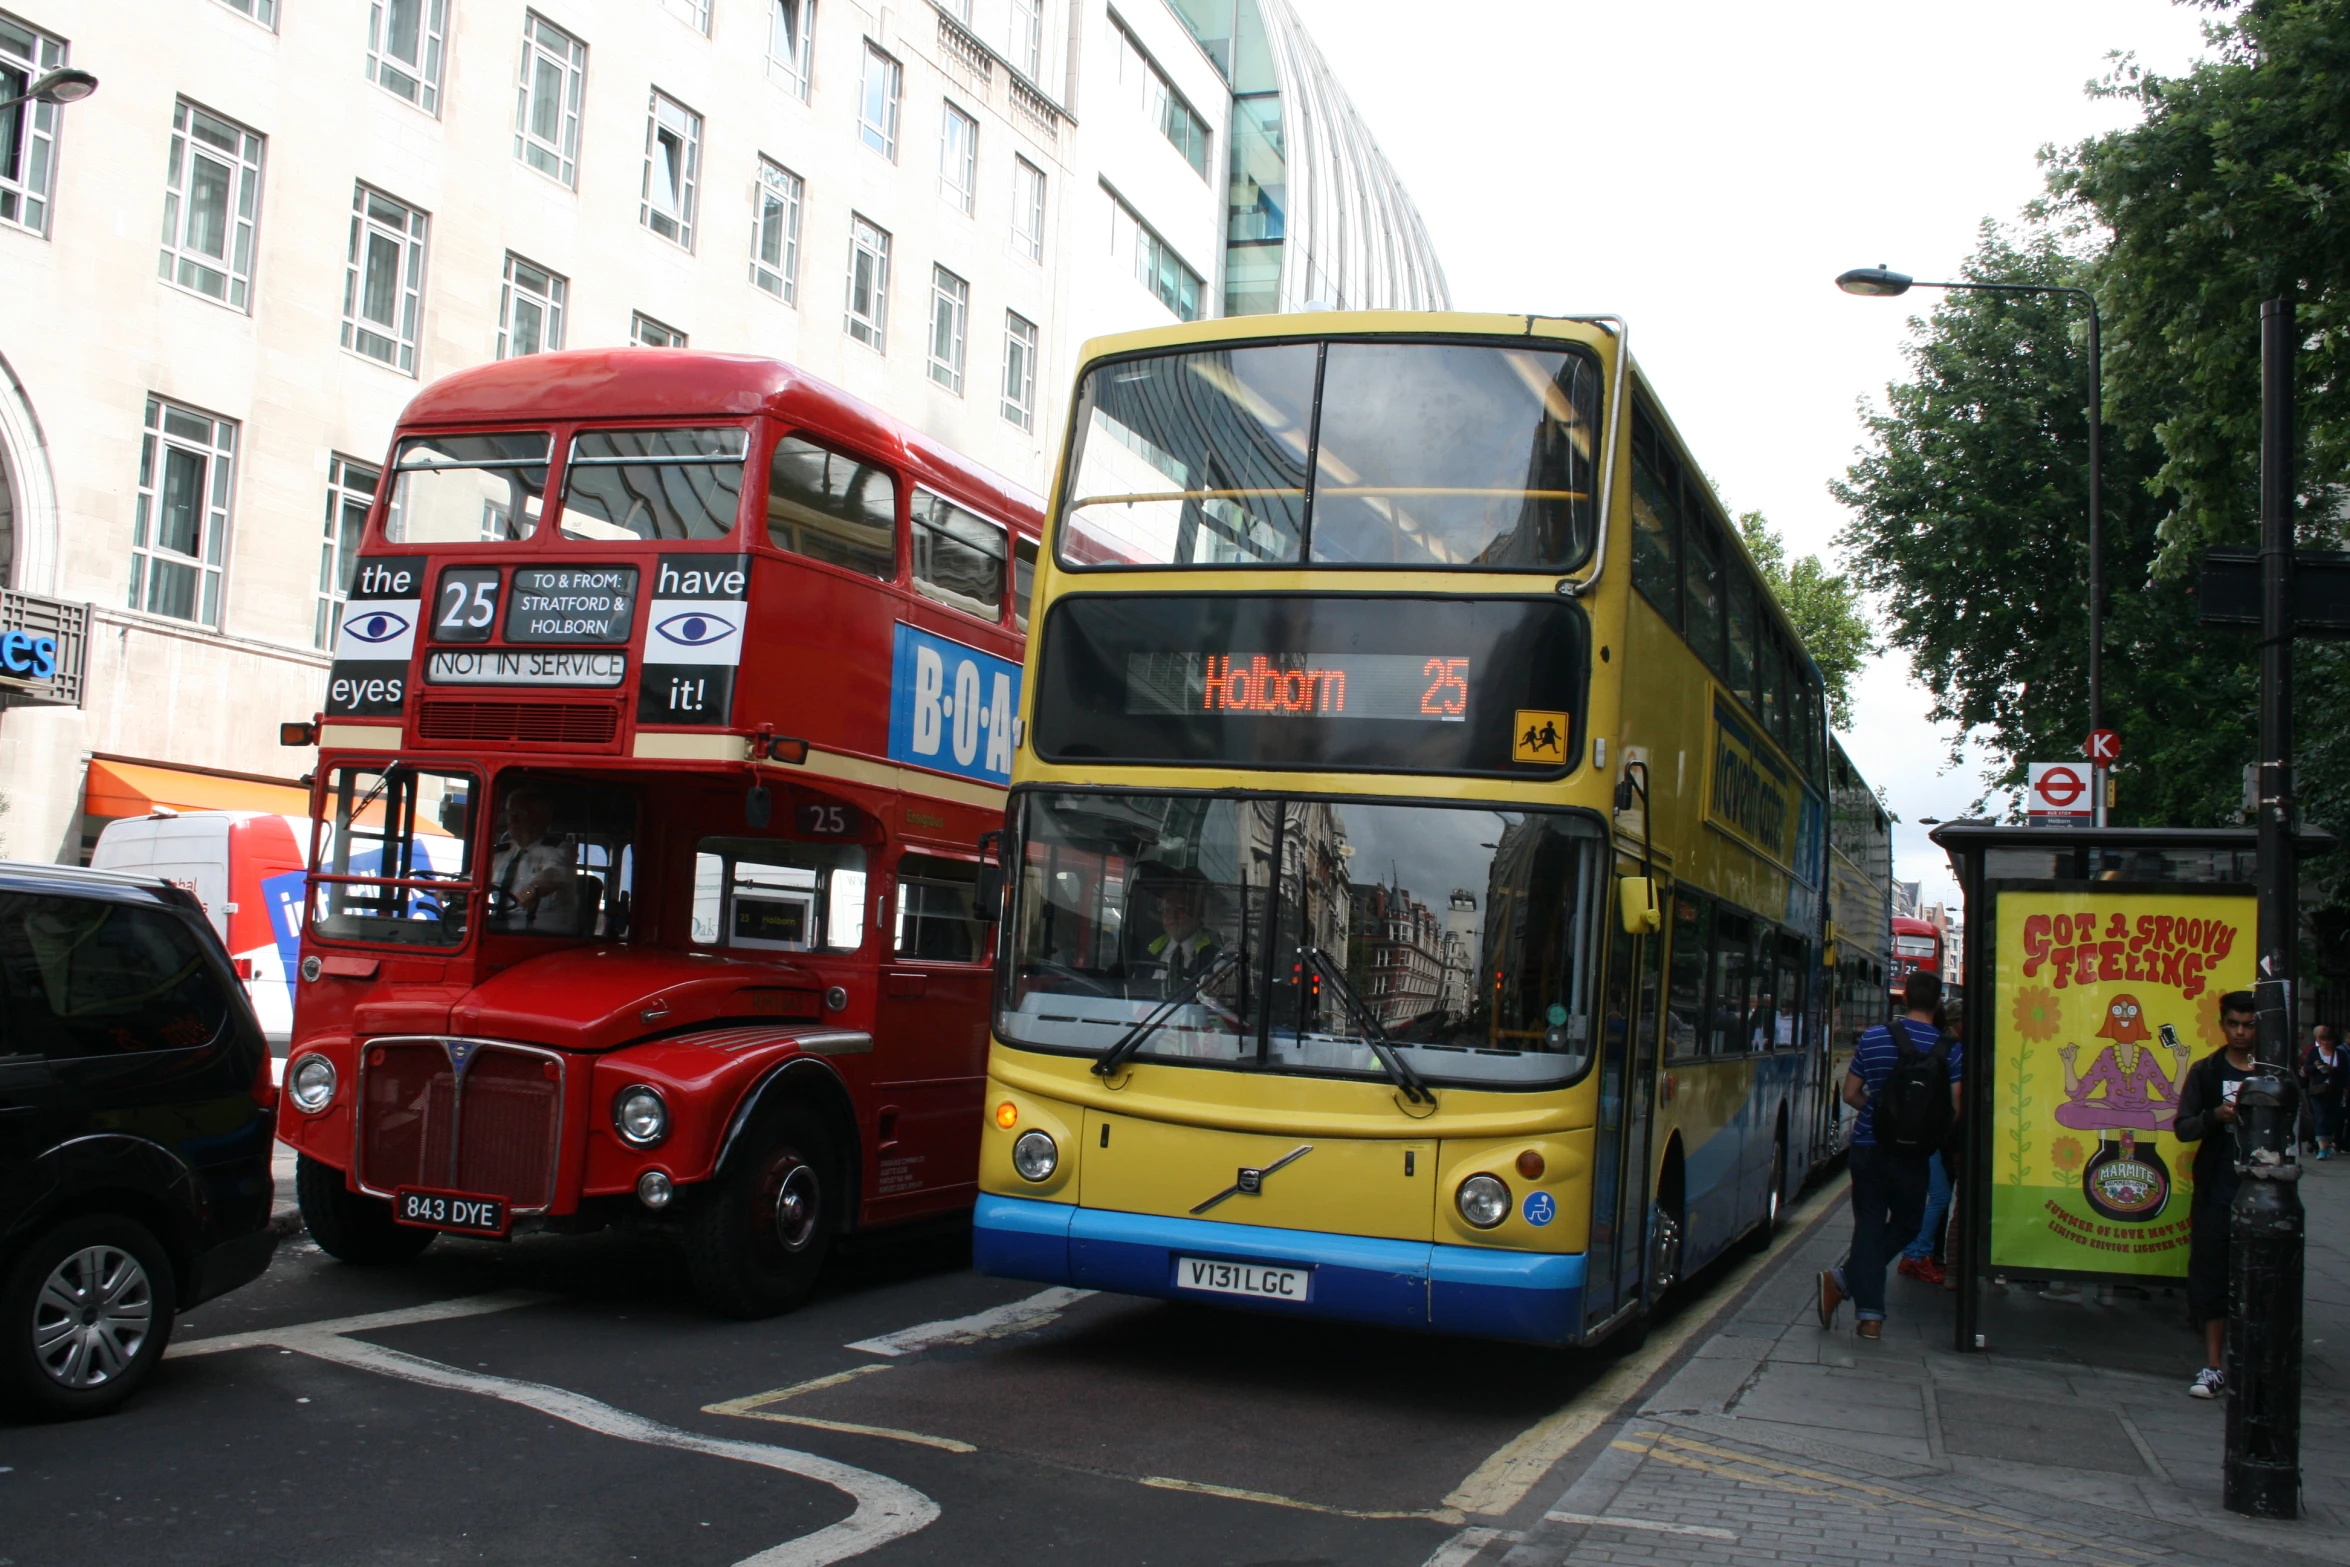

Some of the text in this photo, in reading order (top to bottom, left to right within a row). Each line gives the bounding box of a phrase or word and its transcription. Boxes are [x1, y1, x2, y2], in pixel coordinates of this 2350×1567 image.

[361, 563, 412, 594] the
[533, 573, 623, 589] TO & FROM:
[658, 562, 746, 595] have
[440, 581, 499, 628] 25
[520, 596, 625, 612] STRATFORD &
[530, 618, 609, 635] HOLBORN
[0, 630, 57, 679] es
[435, 653, 624, 677] NOT IN SERVICE
[331, 677, 402, 710] eyes
[669, 677, 705, 711] it!
[1203, 655, 1471, 716] Holborn 25
[2093, 733, 2114, 758] K
[810, 805, 845, 833] 25
[739, 913, 796, 926] 25 Holborn
[2022, 912, 2238, 978] GOT A GROOVY
[1904, 964, 1919, 976] 25
[2050, 940, 2207, 1001] FEELING
[2099, 1163, 2154, 1184] MARMITE
[406, 1195, 494, 1227] 843 DYE
[2044, 1199, 2094, 1233] SUMMER
[2096, 1224, 2111, 1237] OF
[2113, 1227, 2145, 1240] LOVE
[2147, 1223, 2175, 1239] NOT
[2047, 1219, 2088, 1246] LIMITED
[2089, 1238, 2130, 1254] EDITION
[2133, 1239, 2176, 1254] LIGHTER
[1191, 1261, 1295, 1296] V131 LGC
